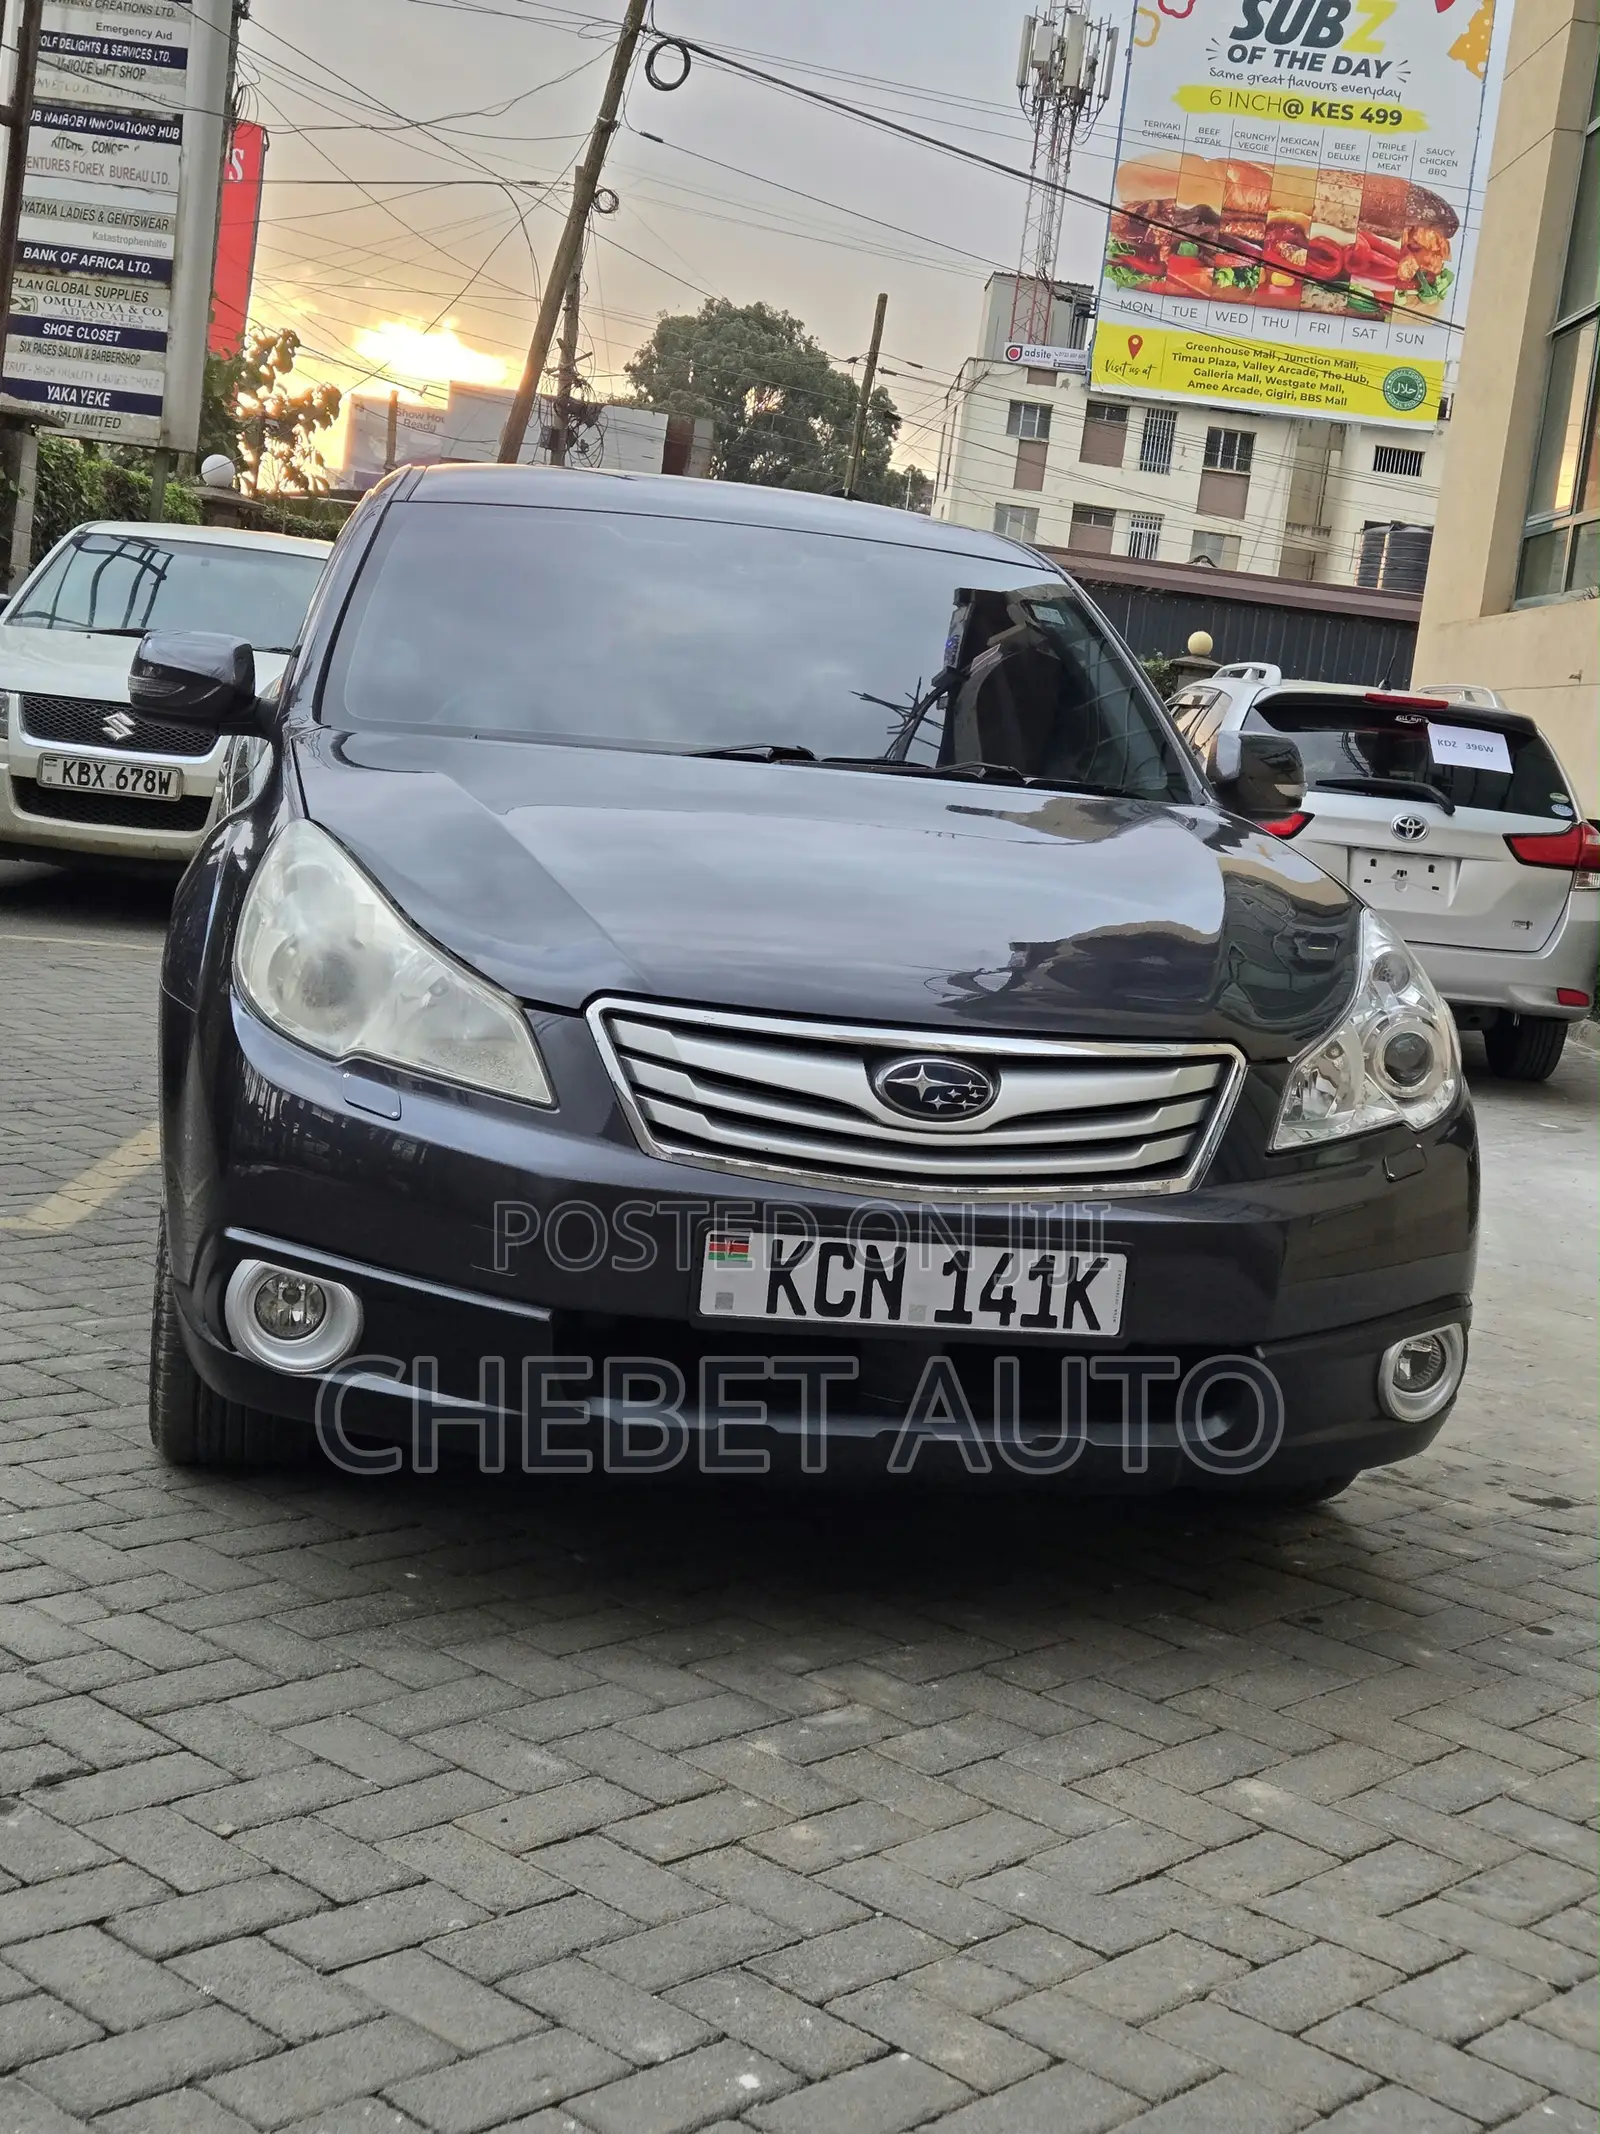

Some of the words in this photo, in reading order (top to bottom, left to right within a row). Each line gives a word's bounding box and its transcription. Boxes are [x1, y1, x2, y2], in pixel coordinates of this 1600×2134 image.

[95, 22, 153, 39] Emergency
[155, 30, 173, 41] Aid
[1229, 0, 1398, 55] SUBZ
[40, 35, 57, 48] OLF
[58, 38, 101, 55] DELIGHTS
[102, 44, 109, 55] &
[110, 44, 153, 61] SERVICES
[153, 50, 171, 63] LTD.
[1227, 44, 1266, 65] OF
[1273, 49, 1325, 72] THE
[1332, 56, 1393, 79] DAY
[95, 62, 119, 77] GIFT
[119, 66, 147, 80] SHOP
[1247, 72, 1285, 86] great
[1286, 74, 1338, 93] flavours
[1340, 83, 1402, 103] everyday
[1209, 89, 1222, 106] 6
[1311, 101, 1355, 121] KES
[1360, 107, 1403, 126] 499
[44, 111, 88, 128] NAIROBI
[88, 116, 156, 136] INNOVATIONS
[157, 126, 181, 139] HUB
[1143, 119, 1181, 131] TERIYAKI
[1198, 126, 1221, 136] BEEF
[1141, 130, 1180, 141] CHICKEN
[1194, 136, 1222, 147] STEAK
[1234, 130, 1277, 142] CRUNCHY
[1280, 136, 1320, 147] MEXICAN
[1238, 141, 1270, 152] VEGGIE
[1279, 146, 1318, 157] CHICKEN
[1334, 142, 1357, 151] BEEF
[1377, 141, 1407, 152] TRIPLE
[1426, 147, 1455, 157] SAUCY
[1327, 151, 1361, 162] DELUXE
[1371, 151, 1409, 162] DELIGHT
[1419, 157, 1459, 168] CHICKEN
[26, 155, 71, 172] ENTURES
[73, 160, 105, 177] FOREX
[109, 165, 150, 183] BUREAU
[151, 172, 170, 186] LTD.
[1376, 162, 1402, 172] MEAT
[1427, 167, 1448, 177] BBQ
[60, 205, 96, 221] LADIES
[98, 211, 104, 222] &
[107, 211, 170, 231] GENTSWEAR
[23, 246, 58, 262] BANK
[60, 252, 78, 264] OF
[79, 254, 125, 271] AFRICA
[128, 260, 153, 275] LTD.
[45, 279, 91, 297] GLOBAL
[94, 285, 150, 304] SUPPLIES
[43, 295, 124, 315] OMULANYA
[128, 305, 138, 315] &
[142, 306, 164, 318] CO.
[1120, 299, 1154, 313] MON
[1172, 305, 1198, 319] TUE
[60, 306, 144, 324] ADVOCATES
[1215, 310, 1249, 324] WED
[1262, 315, 1290, 329] THU
[42, 322, 75, 338] SHOE
[76, 326, 121, 342] CLOSET
[1309, 321, 1331, 334] FRI
[1352, 327, 1378, 340] SAT
[1395, 332, 1425, 345] SUN
[19, 340, 32, 352] SIX
[32, 342, 57, 357] PAGES
[58, 345, 83, 360] SALON
[83, 350, 90, 360] &
[91, 350, 141, 366] BARBERSHOP
[1024, 348, 1052, 359] adsite
[1185, 341, 1250, 357] Greenhouse
[1284, 352, 1332, 365] Junction
[1334, 359, 1360, 371] Mall,
[1105, 359, 1130, 376] Visit
[1129, 366, 1140, 374] us
[1141, 363, 1157, 380] at
[1172, 352, 1205, 364] Timau
[1208, 356, 1240, 370] Plaza,
[1243, 360, 1275, 374] Valley
[1277, 365, 1319, 379] Arcade,
[1322, 370, 1342, 380] The
[1344, 373, 1370, 385] Hub,
[1193, 368, 1234, 380] Galleria
[1236, 373, 1263, 385] Mall,
[1265, 376, 1317, 390] Westgate
[1319, 381, 1345, 394] Mall,
[1392, 382, 1416, 394] حلال
[47, 385, 78, 402] YAKA
[79, 389, 112, 407] YEKE
[1187, 379, 1219, 391] Amee
[1221, 383, 1263, 398] Arcade,
[1265, 388, 1297, 401] Gigiri,
[1300, 392, 1323, 403] BBS
[73, 413, 121, 429] LIMITED
[403, 418, 437, 432] Ready
[1437, 739, 1458, 748] KDZ
[1465, 742, 1494, 753] 396W
[62, 760, 106, 788] KBX
[113, 766, 173, 796] 678W
[766, 1238, 907, 1321] KCN
[933, 1249, 1109, 1332] 141K
